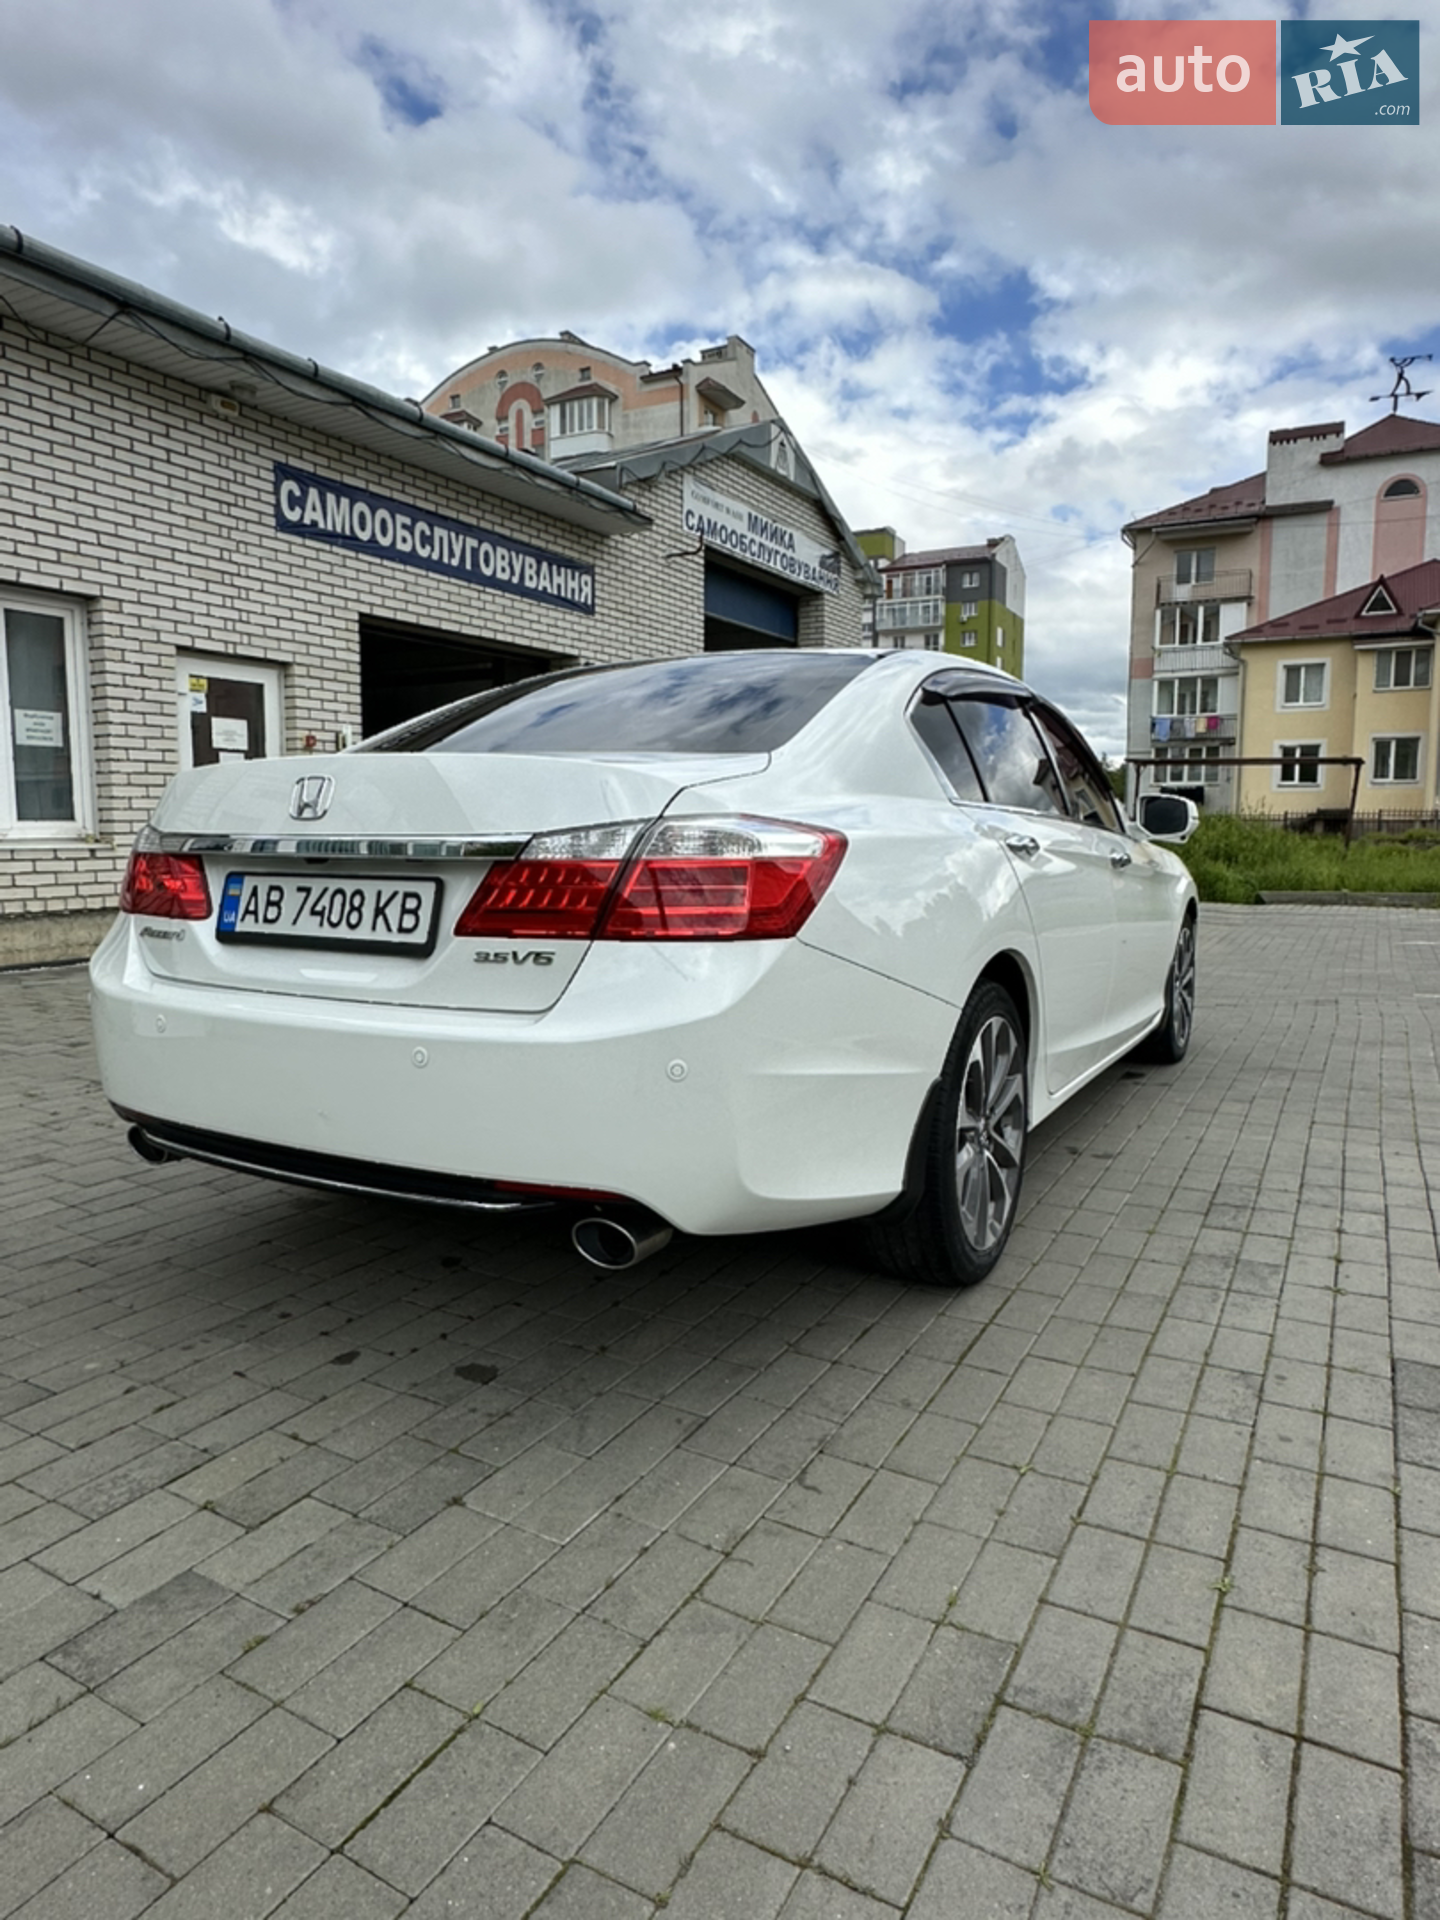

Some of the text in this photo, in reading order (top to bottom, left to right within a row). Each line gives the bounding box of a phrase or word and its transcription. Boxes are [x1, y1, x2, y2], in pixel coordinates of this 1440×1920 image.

[279, 480, 592, 605] САМООБСЛУГОВУВАННЯ
[685, 509, 840, 595] САМООБСЛУГОВУВАННЯ
[240, 884, 284, 924] AB
[291, 886, 366, 930] 7408
[372, 890, 422, 934] KB
